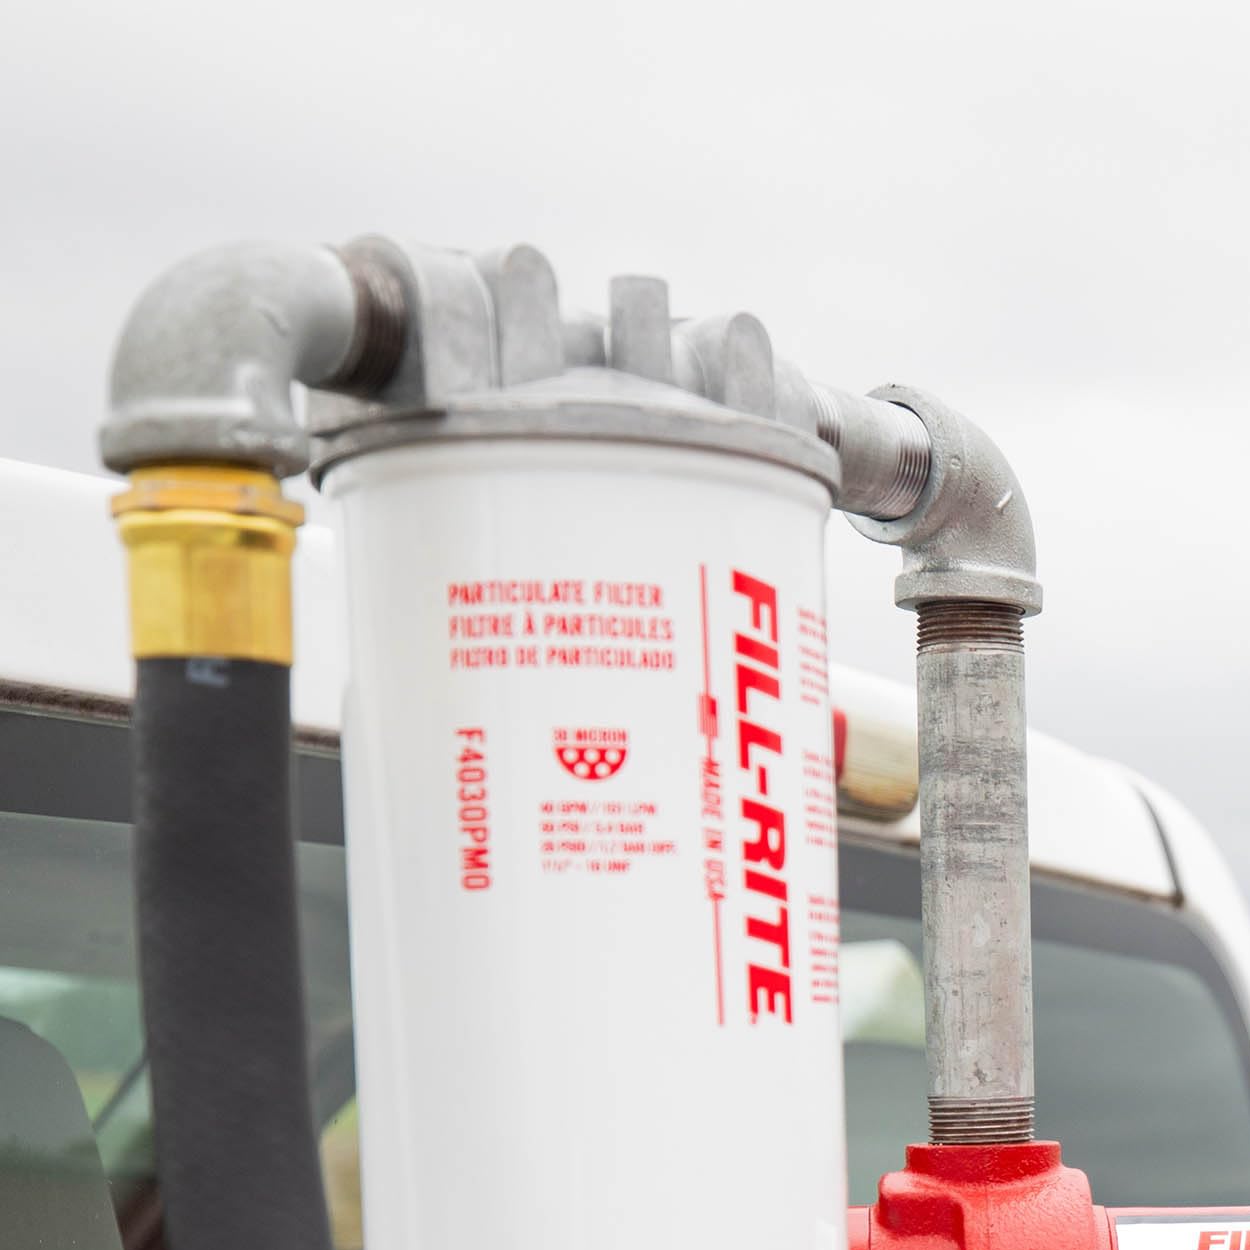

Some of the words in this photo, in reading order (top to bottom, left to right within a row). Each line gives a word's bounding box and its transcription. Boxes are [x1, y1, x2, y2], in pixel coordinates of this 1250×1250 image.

[448, 580, 585, 605] PARTICULATE
[593, 582, 664, 607] FILTER
[448, 615, 513, 639] FILTRE
[524, 610, 535, 635] À
[544, 615, 674, 641] PARTICULES
[450, 647, 508, 670] FILTRO
[517, 647, 537, 666] DE
[546, 647, 676, 670] PARTICULADO
[731, 569, 793, 1025] FILL-RITE
